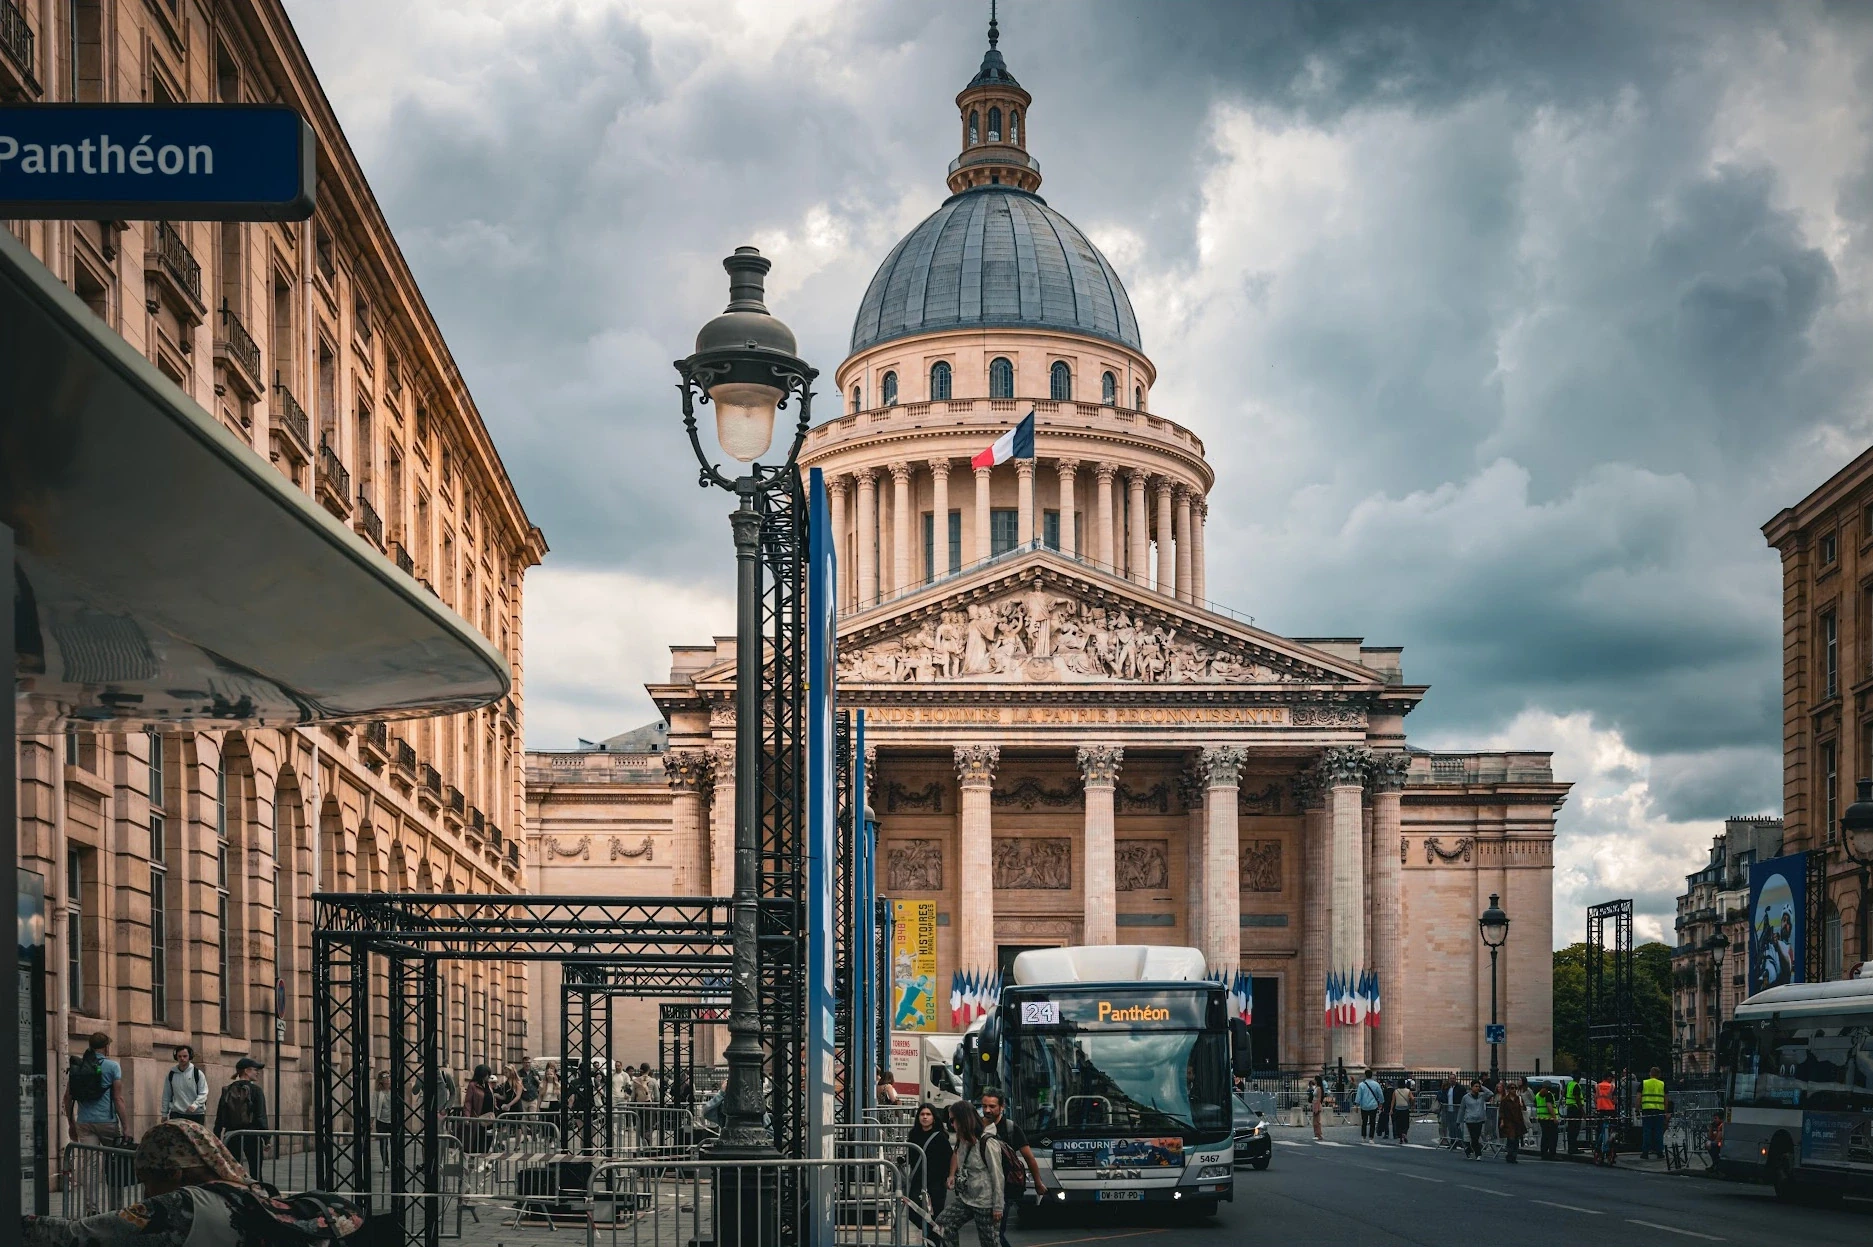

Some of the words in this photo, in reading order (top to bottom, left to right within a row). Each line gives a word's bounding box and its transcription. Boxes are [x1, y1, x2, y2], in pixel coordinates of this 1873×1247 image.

[0, 134, 213, 174] Panthéon
[841, 708, 916, 723] ANDS
[919, 708, 1000, 723] HOMMES
[1012, 708, 1036, 723] LA
[1041, 708, 1109, 723] PATRIE
[1115, 708, 1284, 723] RECONNAISSANTE
[897, 923, 906, 945] 1948
[919, 904, 927, 955] HISTOIRES
[925, 996, 935, 1021] 2024
[1026, 1003, 1053, 1023] 24
[1098, 1001, 1169, 1021] Panthéon
[892, 1040, 910, 1048] TORRENS
[1063, 1141, 1116, 1149] NOCTURNE
[1200, 1155, 1220, 1163] 5467
[1096, 1169, 1141, 1180] MAN
